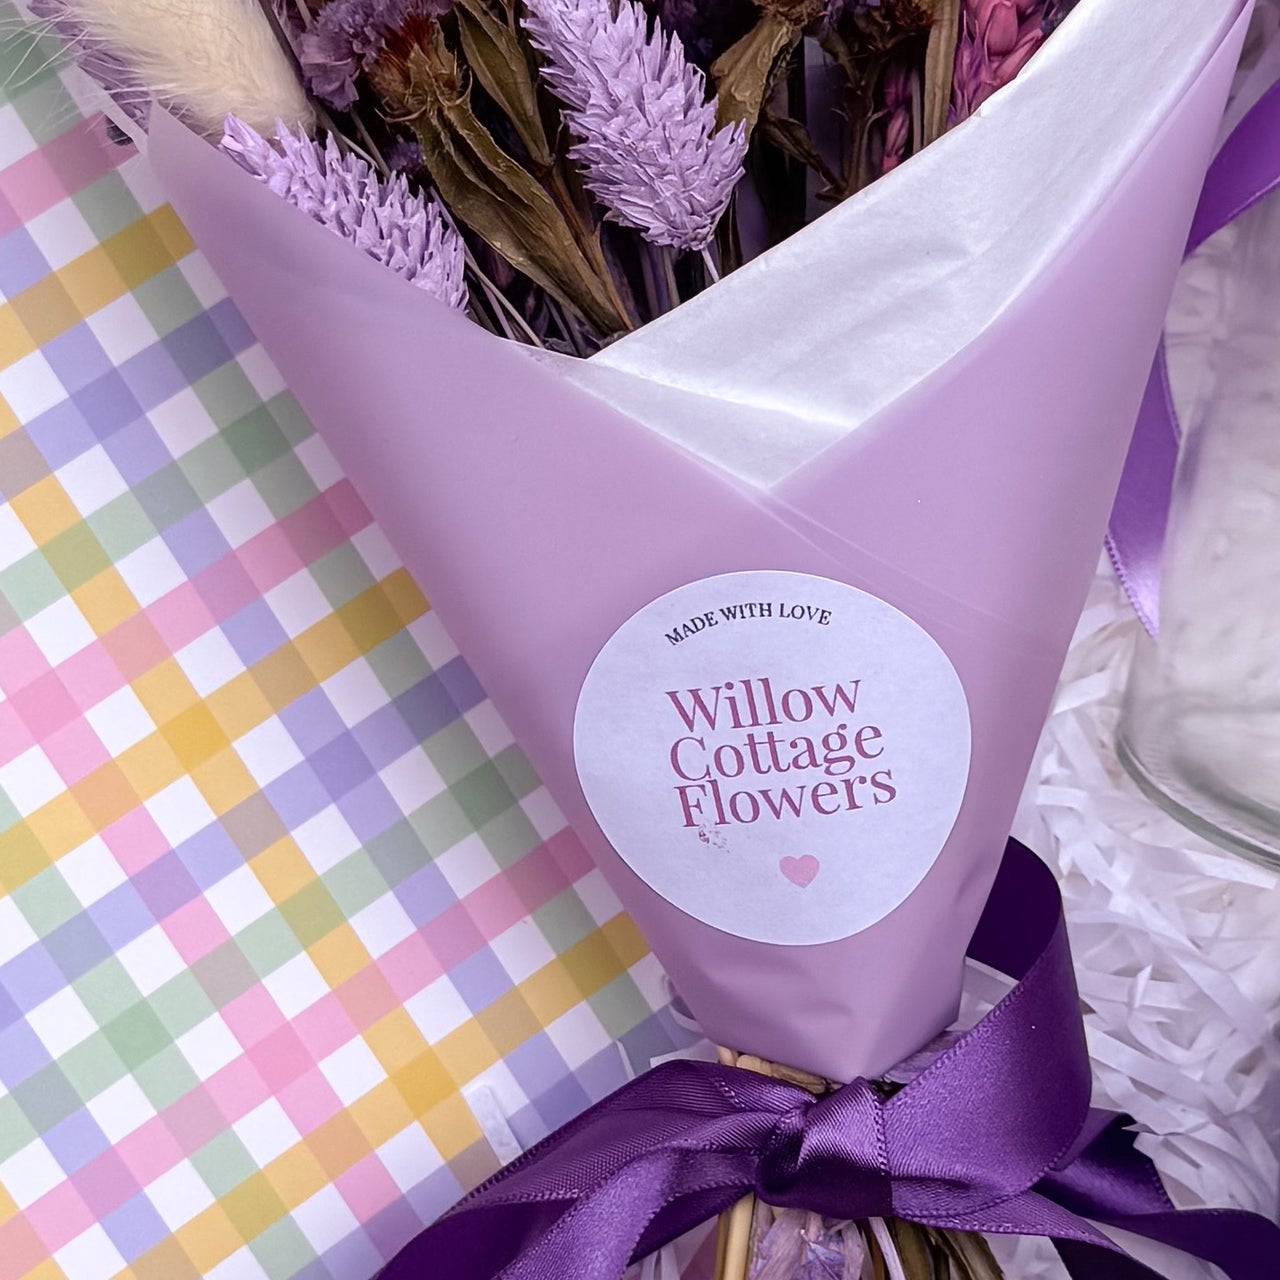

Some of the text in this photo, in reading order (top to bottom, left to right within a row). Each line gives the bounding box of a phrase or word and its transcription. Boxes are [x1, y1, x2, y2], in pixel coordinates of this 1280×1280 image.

[664, 603, 832, 646] MADE WITH LOVE
[665, 677, 862, 733] Willow
[670, 723, 885, 782] Cottage
[673, 769, 897, 828] Flowers
